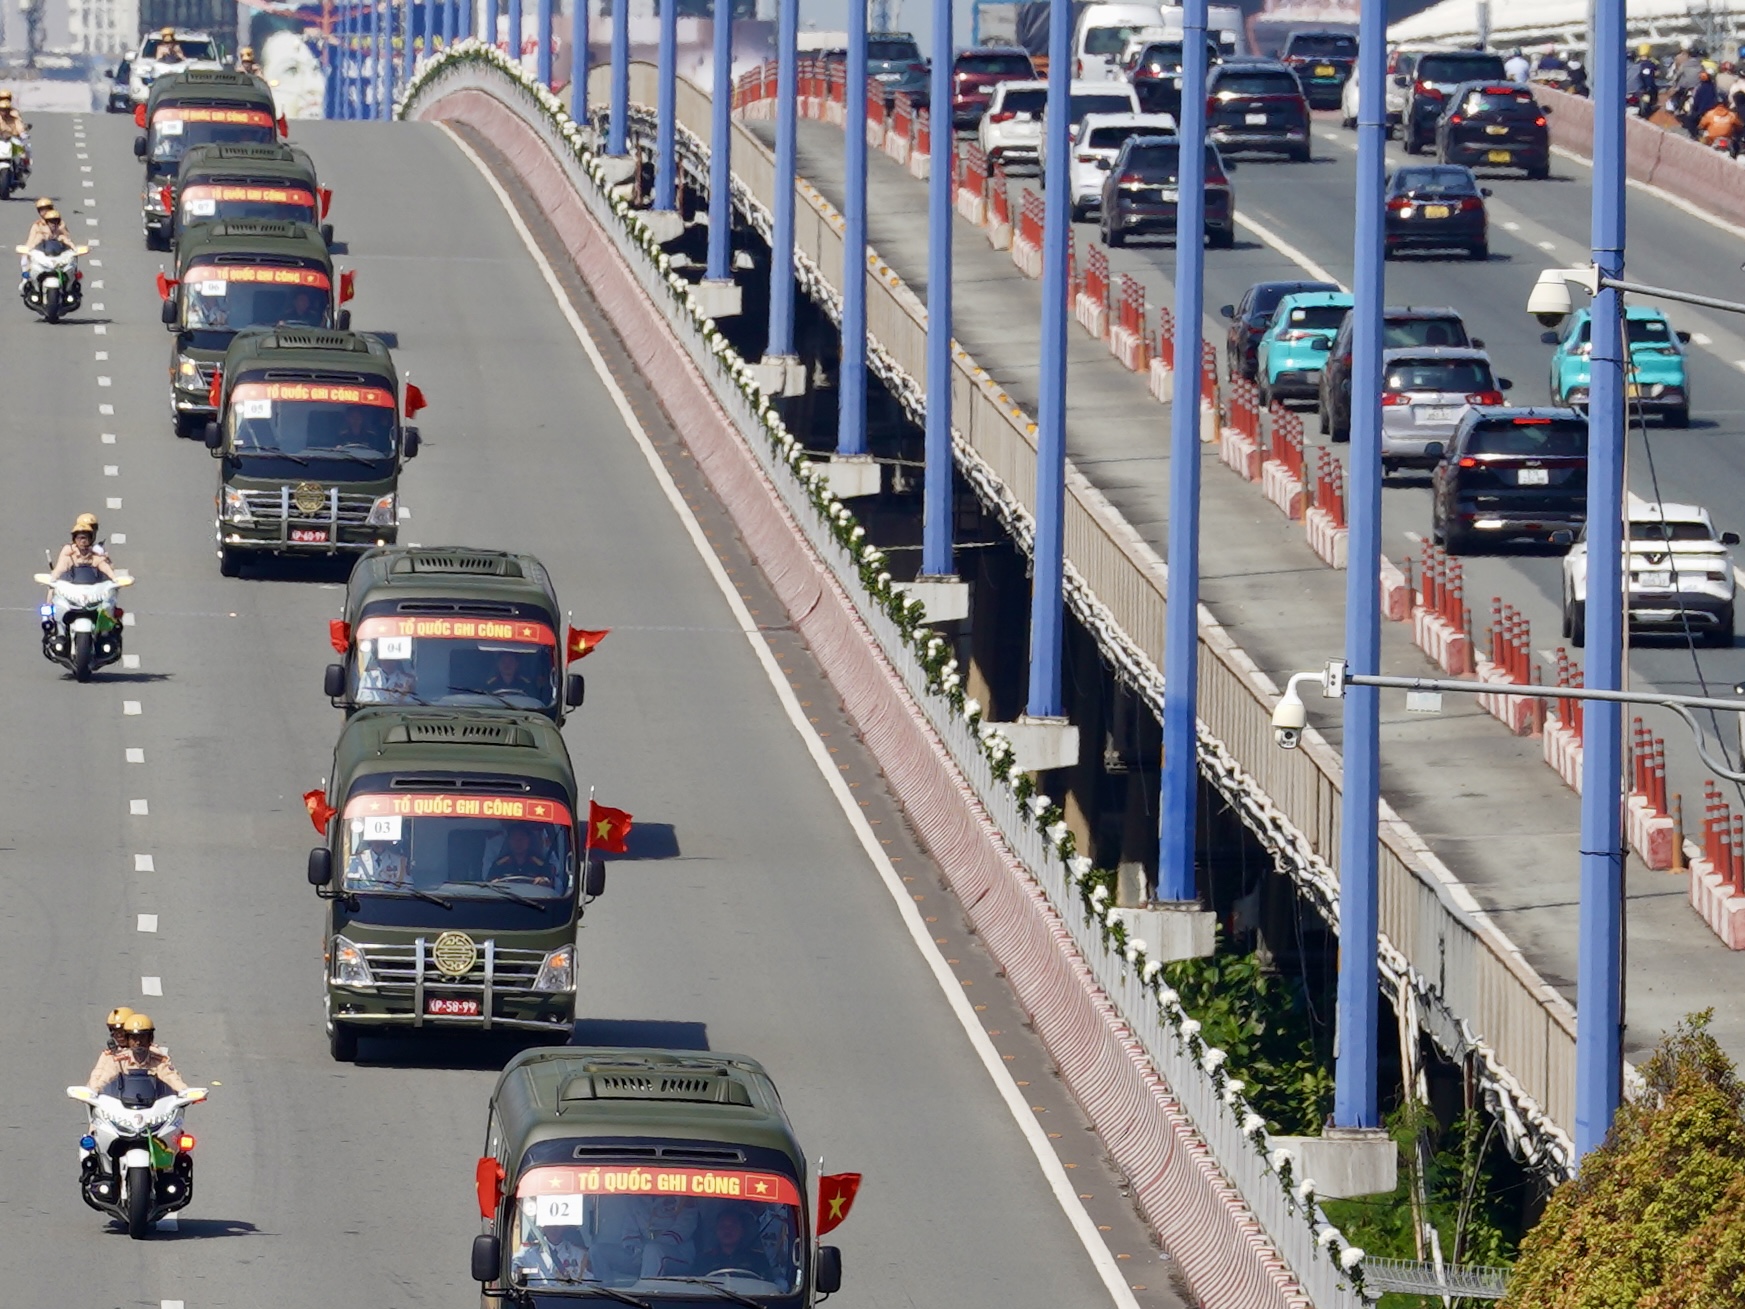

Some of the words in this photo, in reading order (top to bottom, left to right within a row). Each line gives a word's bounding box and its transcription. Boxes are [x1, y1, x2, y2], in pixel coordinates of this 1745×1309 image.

[266, 384, 280, 398] TỔ
[281, 384, 309, 399] QUỐC
[331, 388, 360, 402] CÔNG
[251, 404, 264, 413] 05
[399, 618, 416, 635] TỔ
[417, 618, 451, 636] QUỐC
[453, 623, 475, 637] GHI
[478, 622, 513, 639] CÔNG
[387, 643, 402, 653] 04
[393, 795, 411, 813] TỔ
[414, 794, 452, 814] QUỐC
[456, 800, 480, 815] GHI
[483, 798, 523, 817] CÔNG
[374, 822, 391, 833] 03
[430, 999, 477, 1013] KP-58-99
[578, 1167, 601, 1191] TỔ
[604, 1167, 652, 1192] QUỐC
[657, 1174, 687, 1192] GHI
[691, 1173, 741, 1196] CÔNG
[549, 1201, 570, 1217] 02
